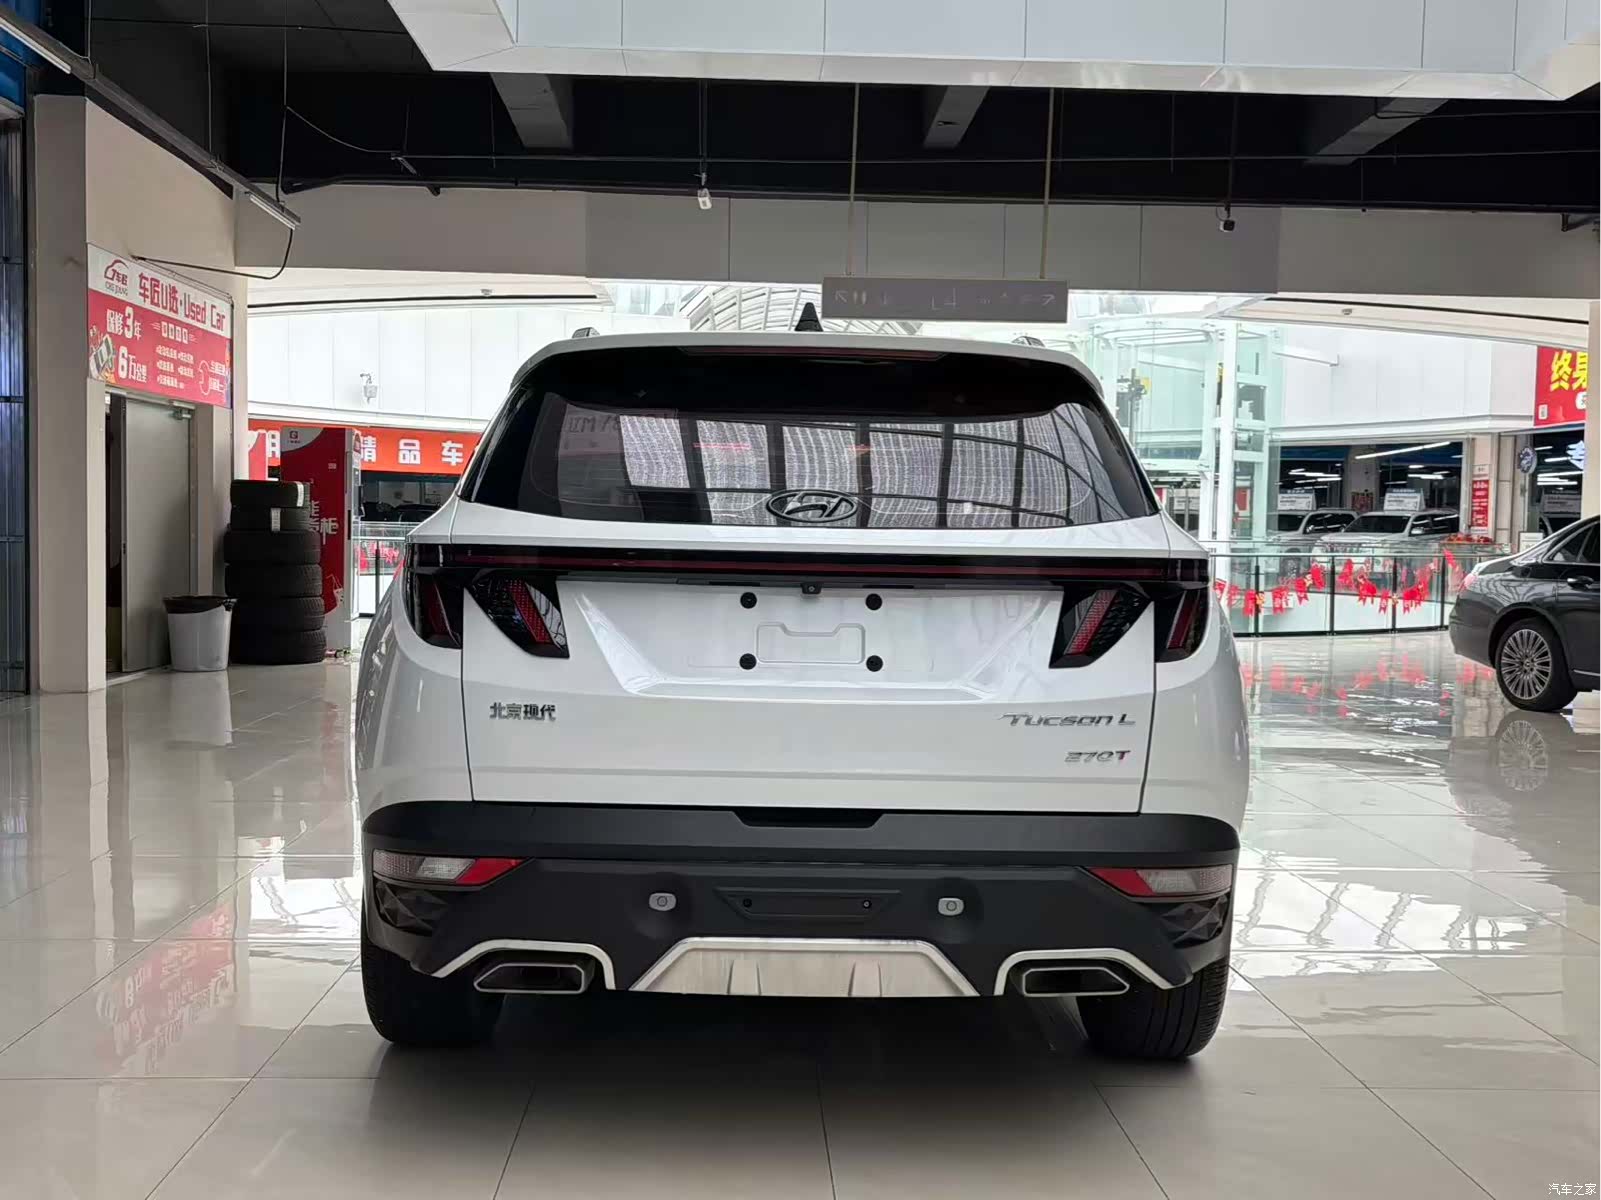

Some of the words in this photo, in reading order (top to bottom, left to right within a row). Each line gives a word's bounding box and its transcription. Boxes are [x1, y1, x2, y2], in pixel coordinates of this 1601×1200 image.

[210, 303, 226, 332] Car
[489, 702, 556, 721] 北京现代
[1118, 713, 1136, 726] L
